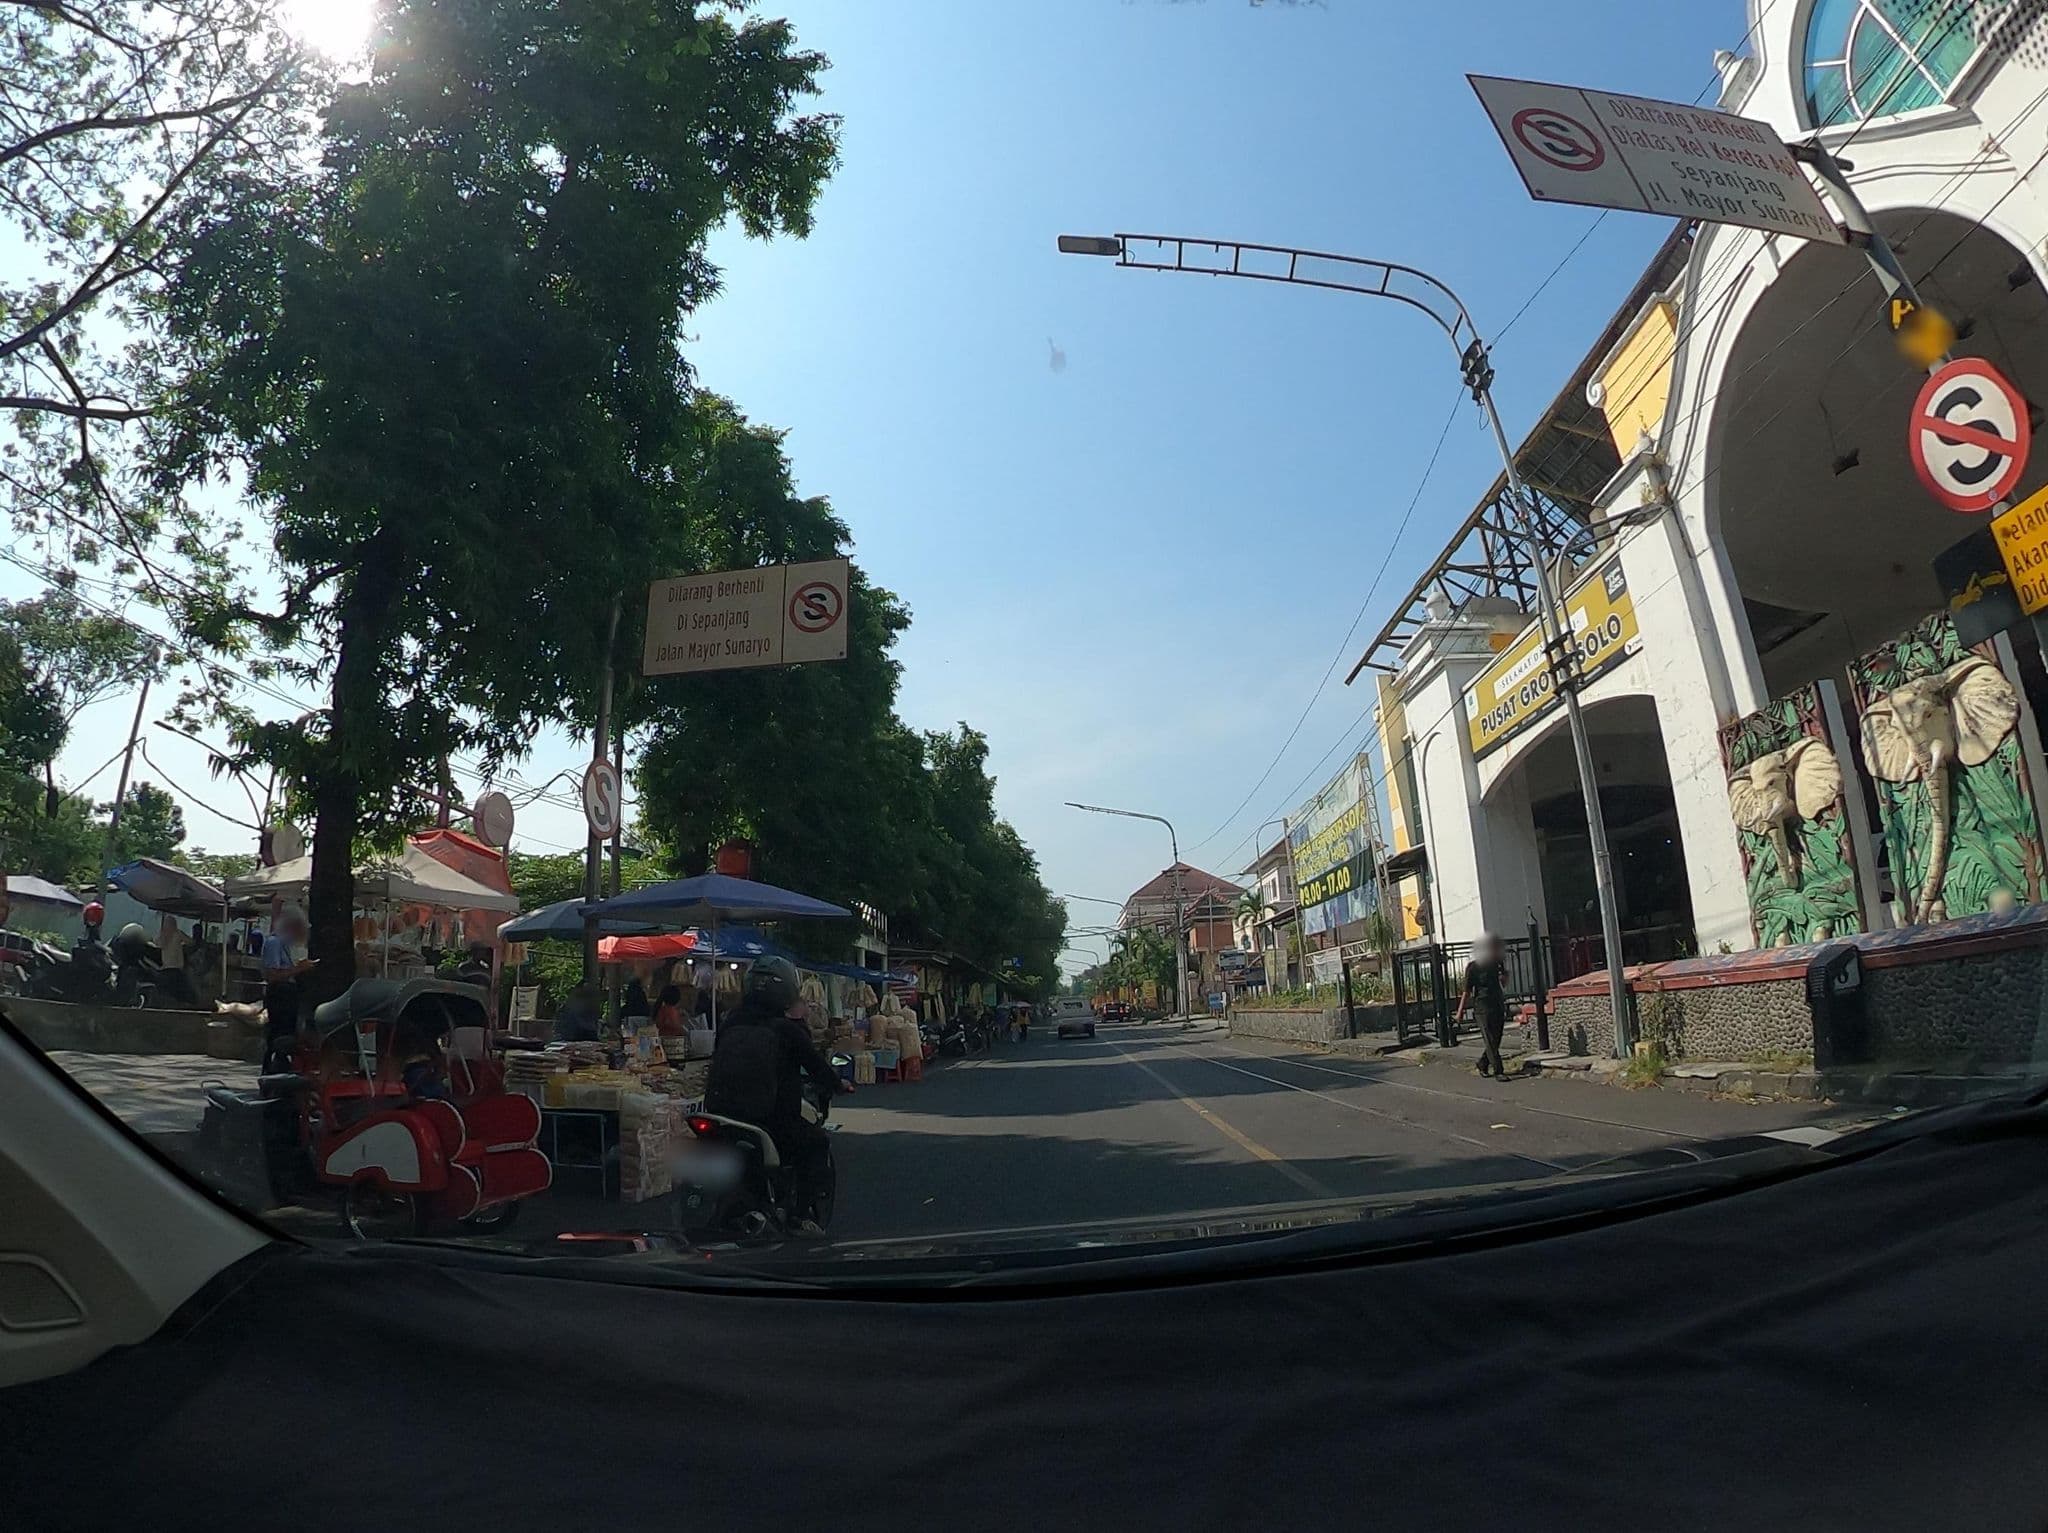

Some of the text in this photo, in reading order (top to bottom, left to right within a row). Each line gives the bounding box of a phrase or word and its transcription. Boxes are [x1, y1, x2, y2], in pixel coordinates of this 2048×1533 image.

[1608, 99, 1767, 144] Dilarang Berhenti
[1611, 126, 1676, 152] Diatas
[1708, 141, 1769, 170] Kereta
[1671, 161, 1787, 202] Sepanjang
[1647, 182, 1832, 235] Jl. Mayor Sunaryo
[1934, 386, 2004, 486] S
[668, 576, 765, 603] Dilarang Berhenti
[677, 609, 749, 632] Di Sepanjang
[655, 637, 771, 663] Jalan Mayor Sunaryo
[1480, 695, 1519, 737] PUSAT
[1577, 614, 1621, 665] SOLO
[1327, 866, 1350, 895] 17.00
